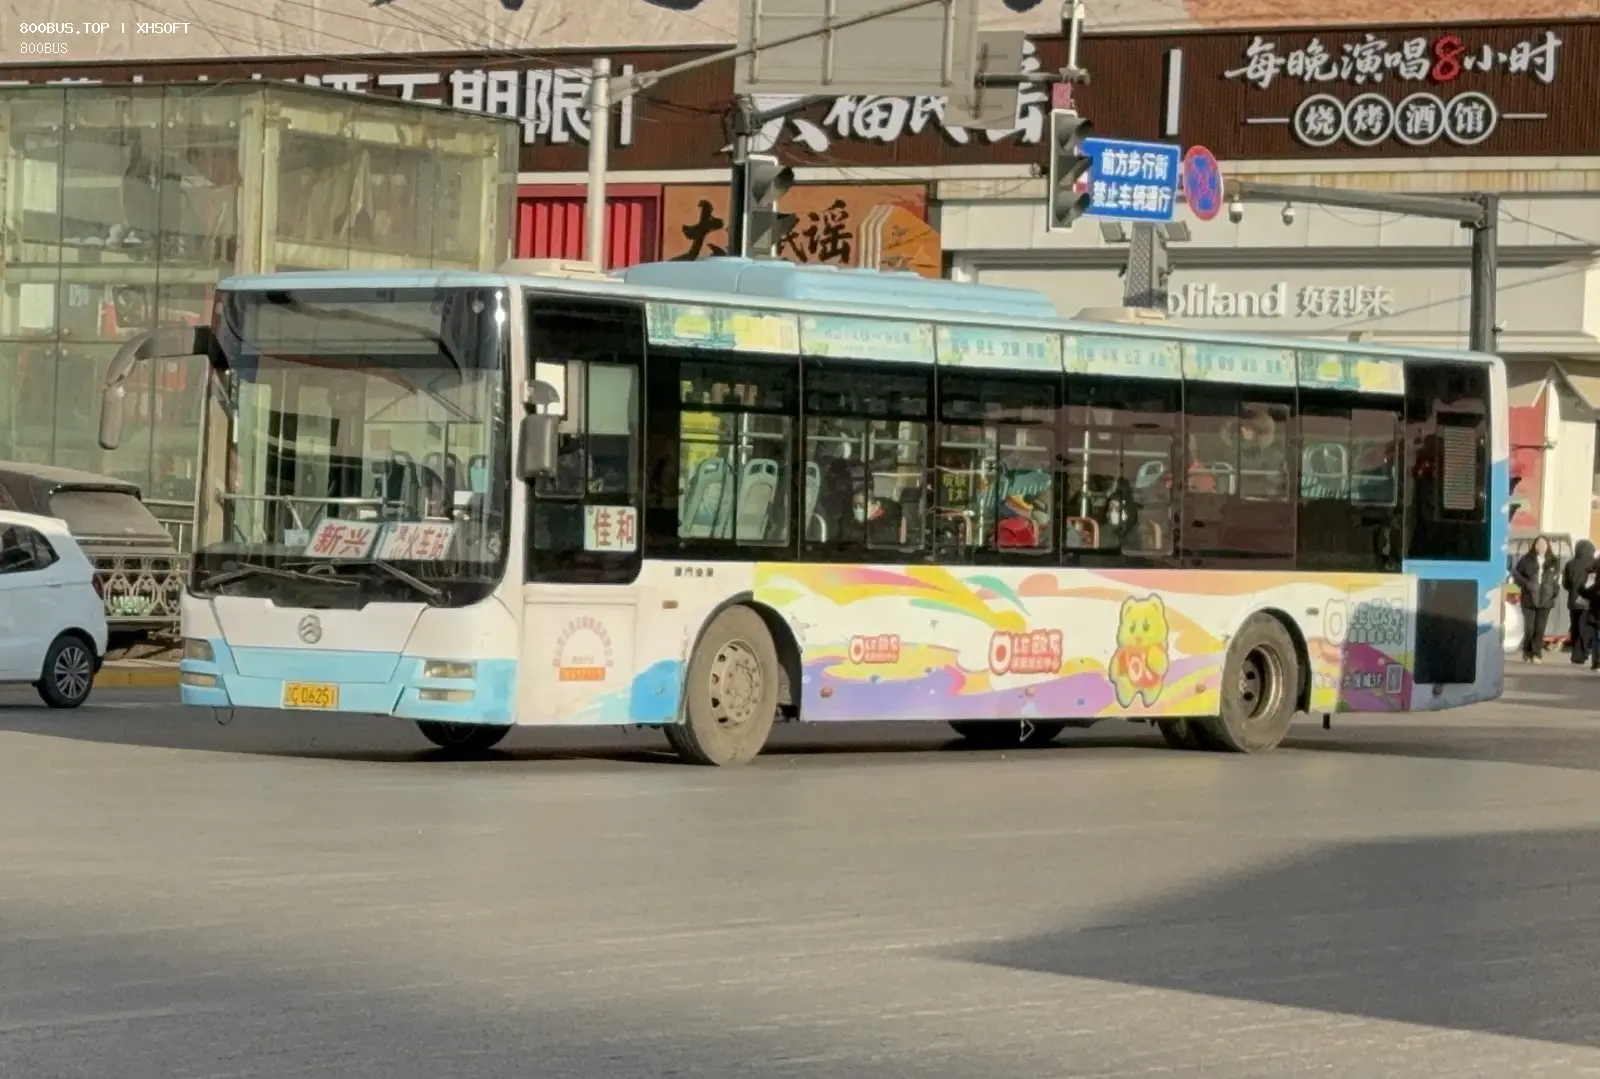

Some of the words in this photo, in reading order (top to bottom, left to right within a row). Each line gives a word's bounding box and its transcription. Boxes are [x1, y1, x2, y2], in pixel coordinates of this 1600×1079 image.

[1224, 31, 1562, 89] 每晚演唱8小时
[1303, 99, 1488, 138] 烧烤酒馆
[1101, 148, 1169, 180] 前方步行街
[1093, 180, 1172, 212] 禁止车辆通行
[1299, 284, 1395, 317] 好利来
[313, 523, 371, 555] 新兴
[592, 508, 635, 549] 佳和
